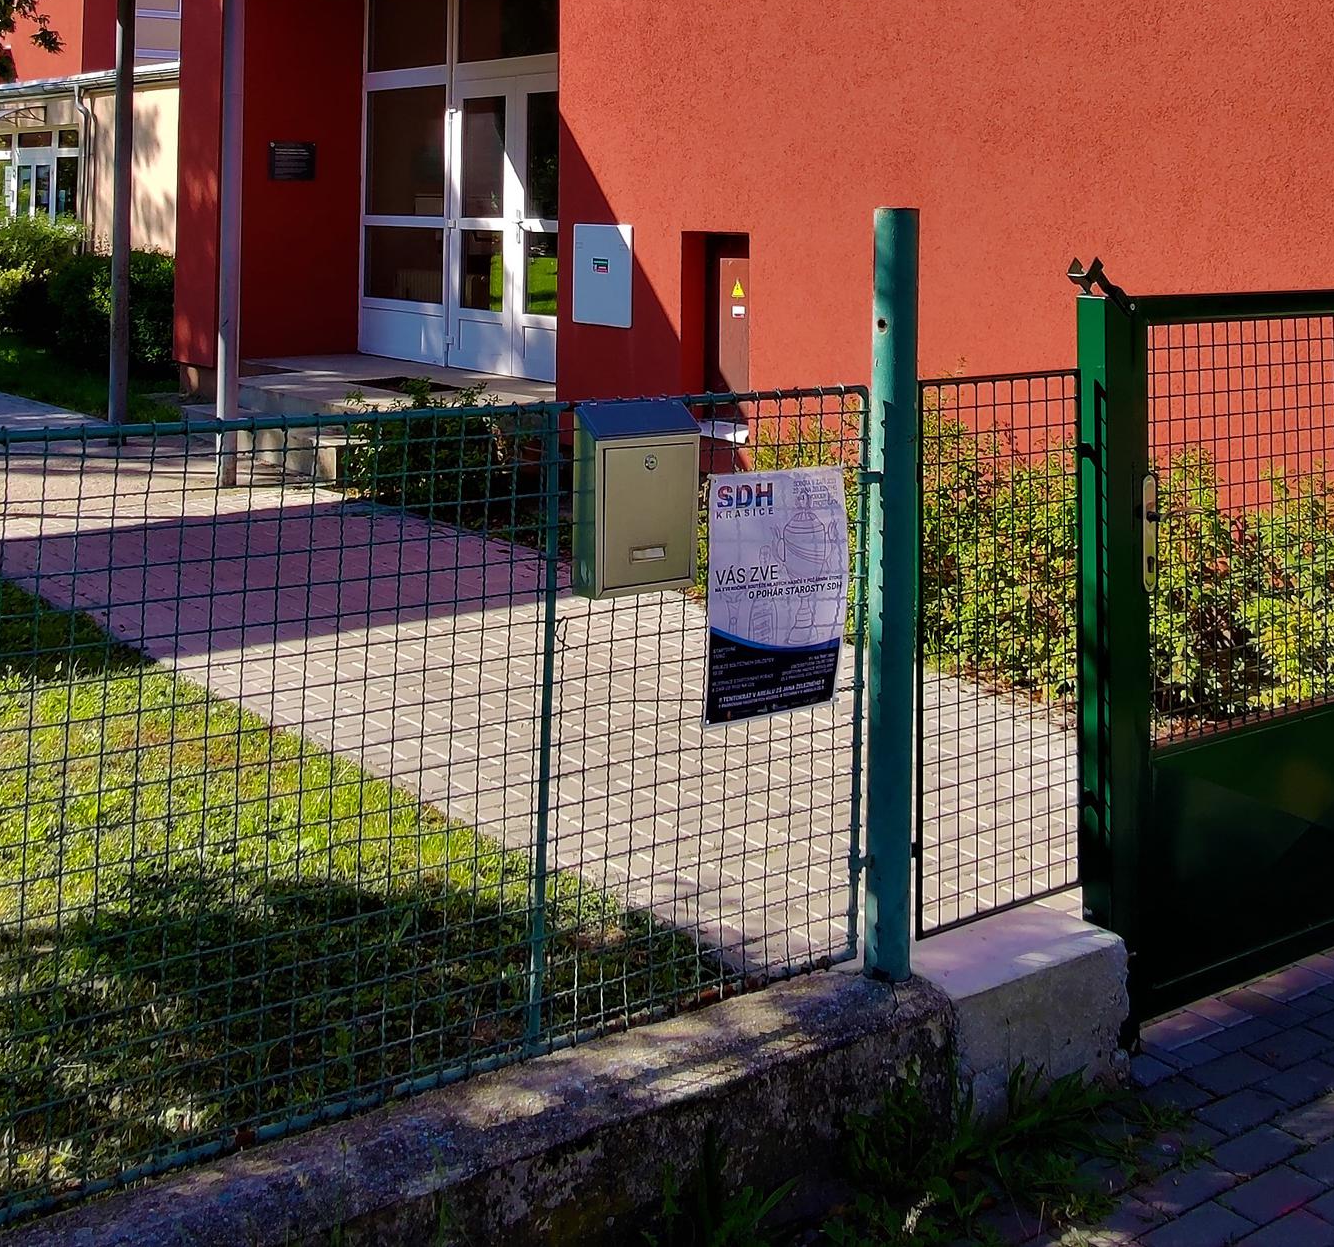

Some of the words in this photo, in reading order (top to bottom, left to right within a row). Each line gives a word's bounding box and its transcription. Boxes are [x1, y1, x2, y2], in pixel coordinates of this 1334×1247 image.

[717, 482, 774, 509] SDH
[716, 508, 775, 520] KRASICE
[715, 565, 746, 586] VÁS
[750, 564, 779, 583] ZVE
[748, 590, 755, 600] O
[756, 587, 784, 599] POHÁR
[785, 583, 826, 595] STAROSTY
[827, 580, 843, 591] SDH
